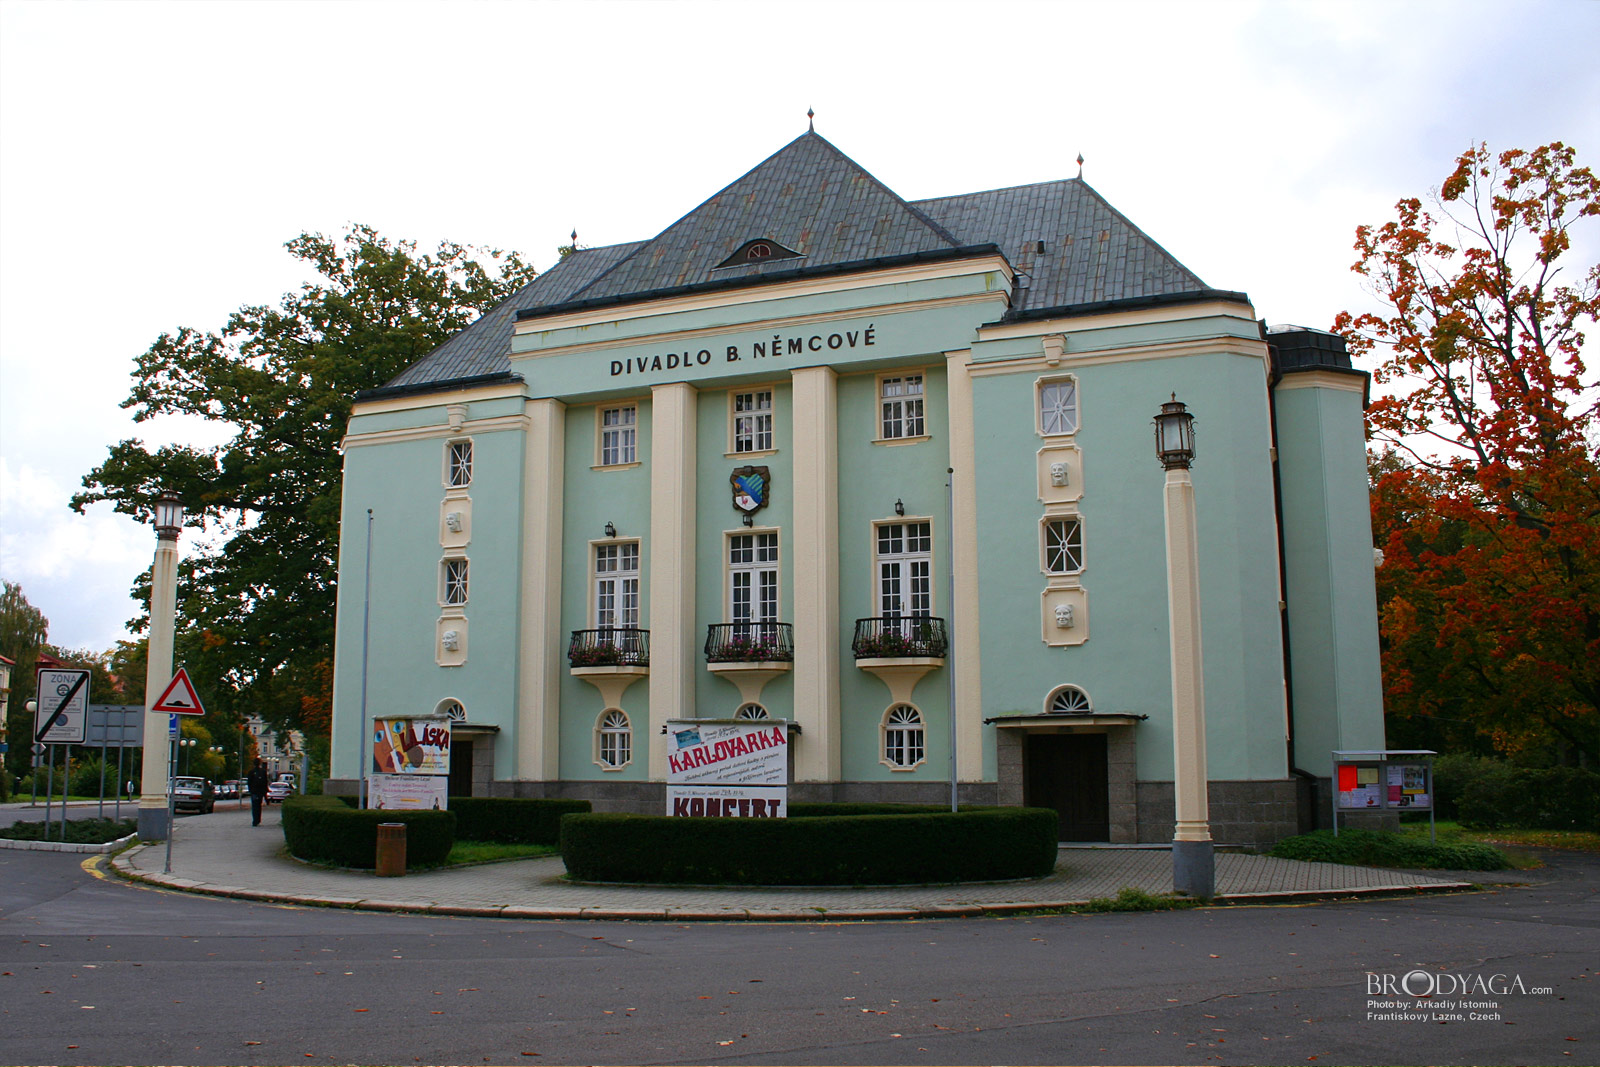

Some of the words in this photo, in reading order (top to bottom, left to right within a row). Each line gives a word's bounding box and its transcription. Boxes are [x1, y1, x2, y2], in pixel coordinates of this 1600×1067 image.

[610, 350, 711, 376] DIVADLO
[726, 345, 742, 362] B.
[753, 324, 876, 359] NĚMCOVÉ
[50, 674, 76, 683] ZONA
[668, 726, 786, 774] KARLOVARKA
[674, 797, 781, 817] KONCERT
